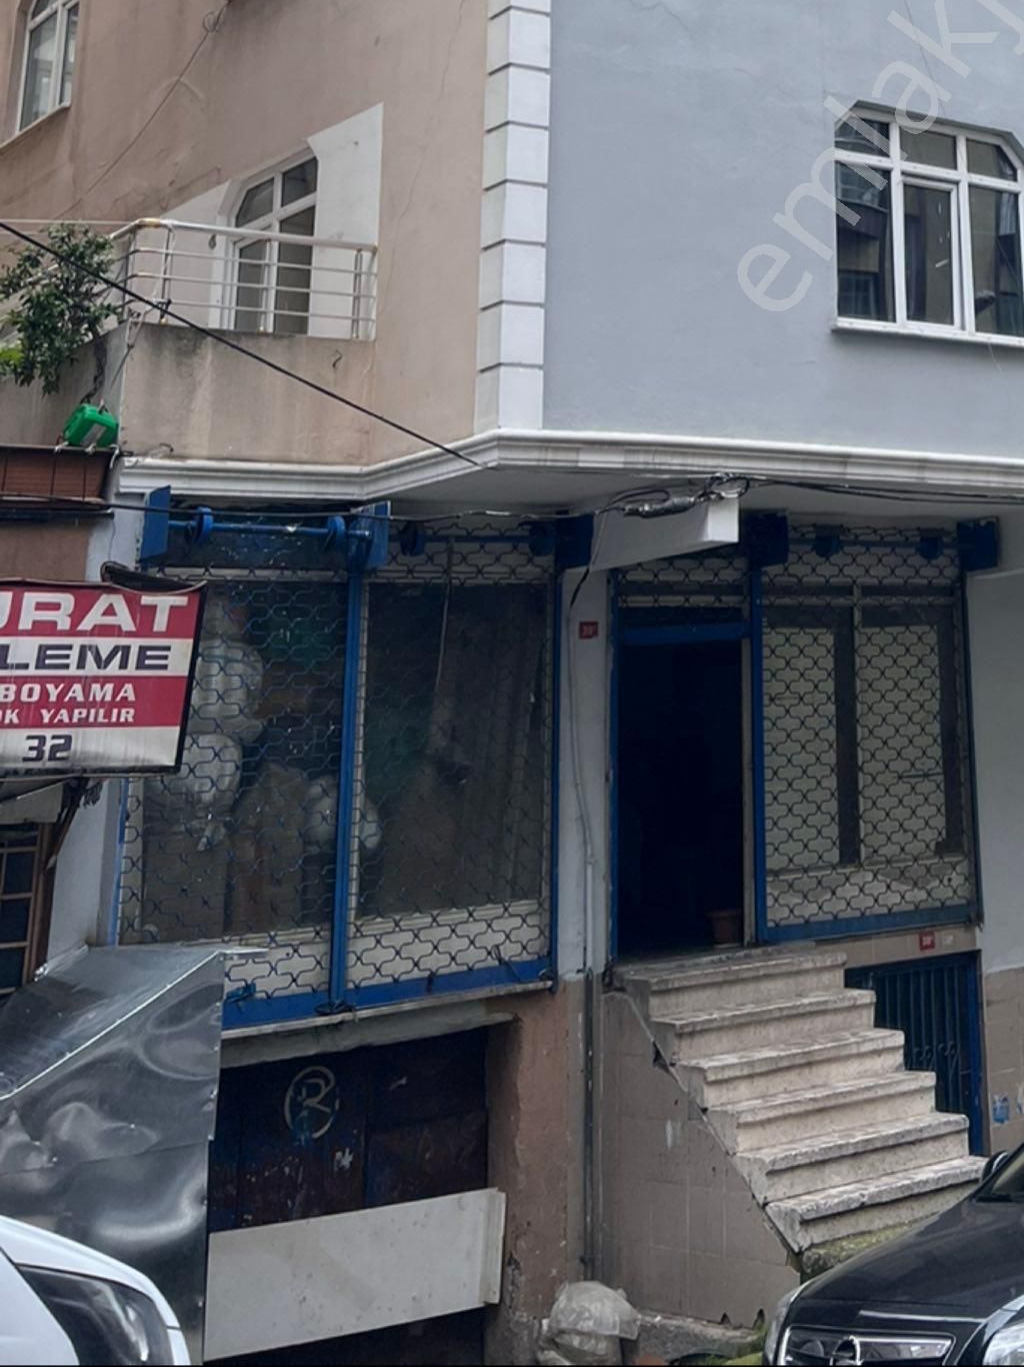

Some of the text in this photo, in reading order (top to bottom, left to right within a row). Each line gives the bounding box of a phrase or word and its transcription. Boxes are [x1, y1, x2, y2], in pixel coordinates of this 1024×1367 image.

[0, 591, 188, 632] RAT
[0, 683, 136, 702] BOYAMA
[0, 708, 135, 724] K YAPILIR
[22, 735, 73, 762] 32
